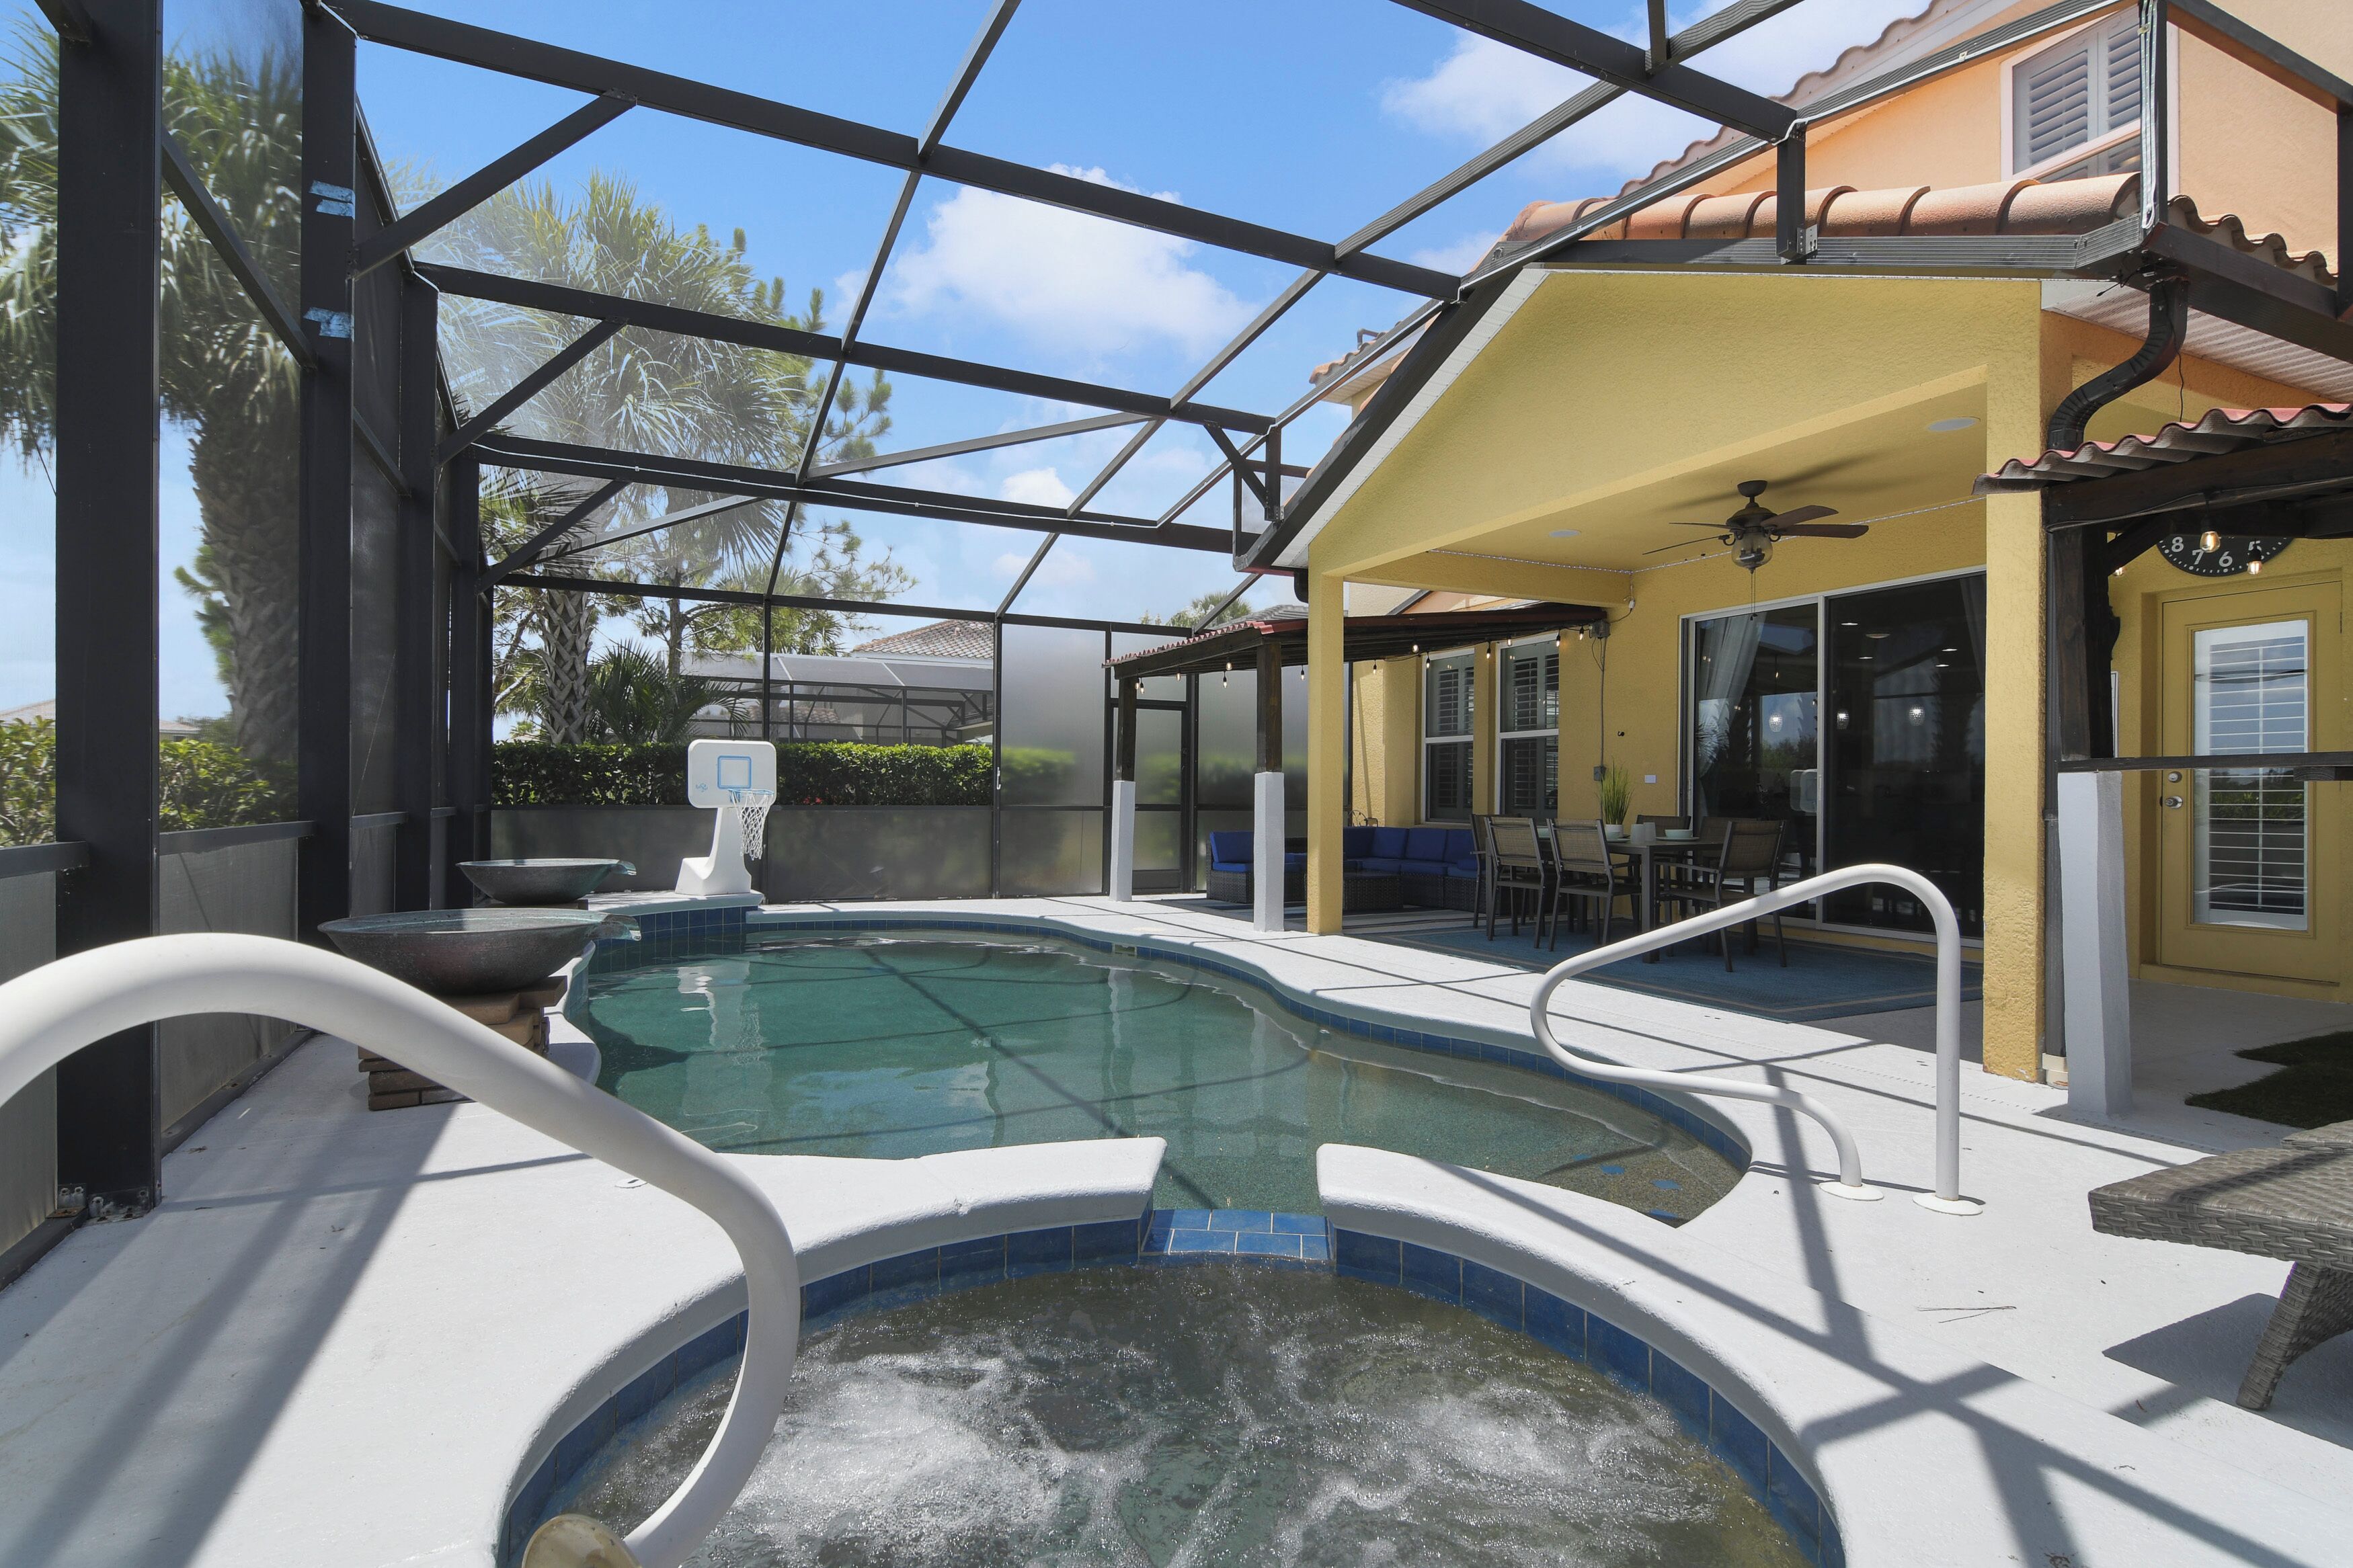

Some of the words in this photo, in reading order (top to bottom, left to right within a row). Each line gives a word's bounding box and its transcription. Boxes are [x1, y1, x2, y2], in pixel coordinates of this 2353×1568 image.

[2171, 536, 2184, 552] 8
[2192, 548, 2204, 565] 7
[2219, 551, 2233, 567] 6
